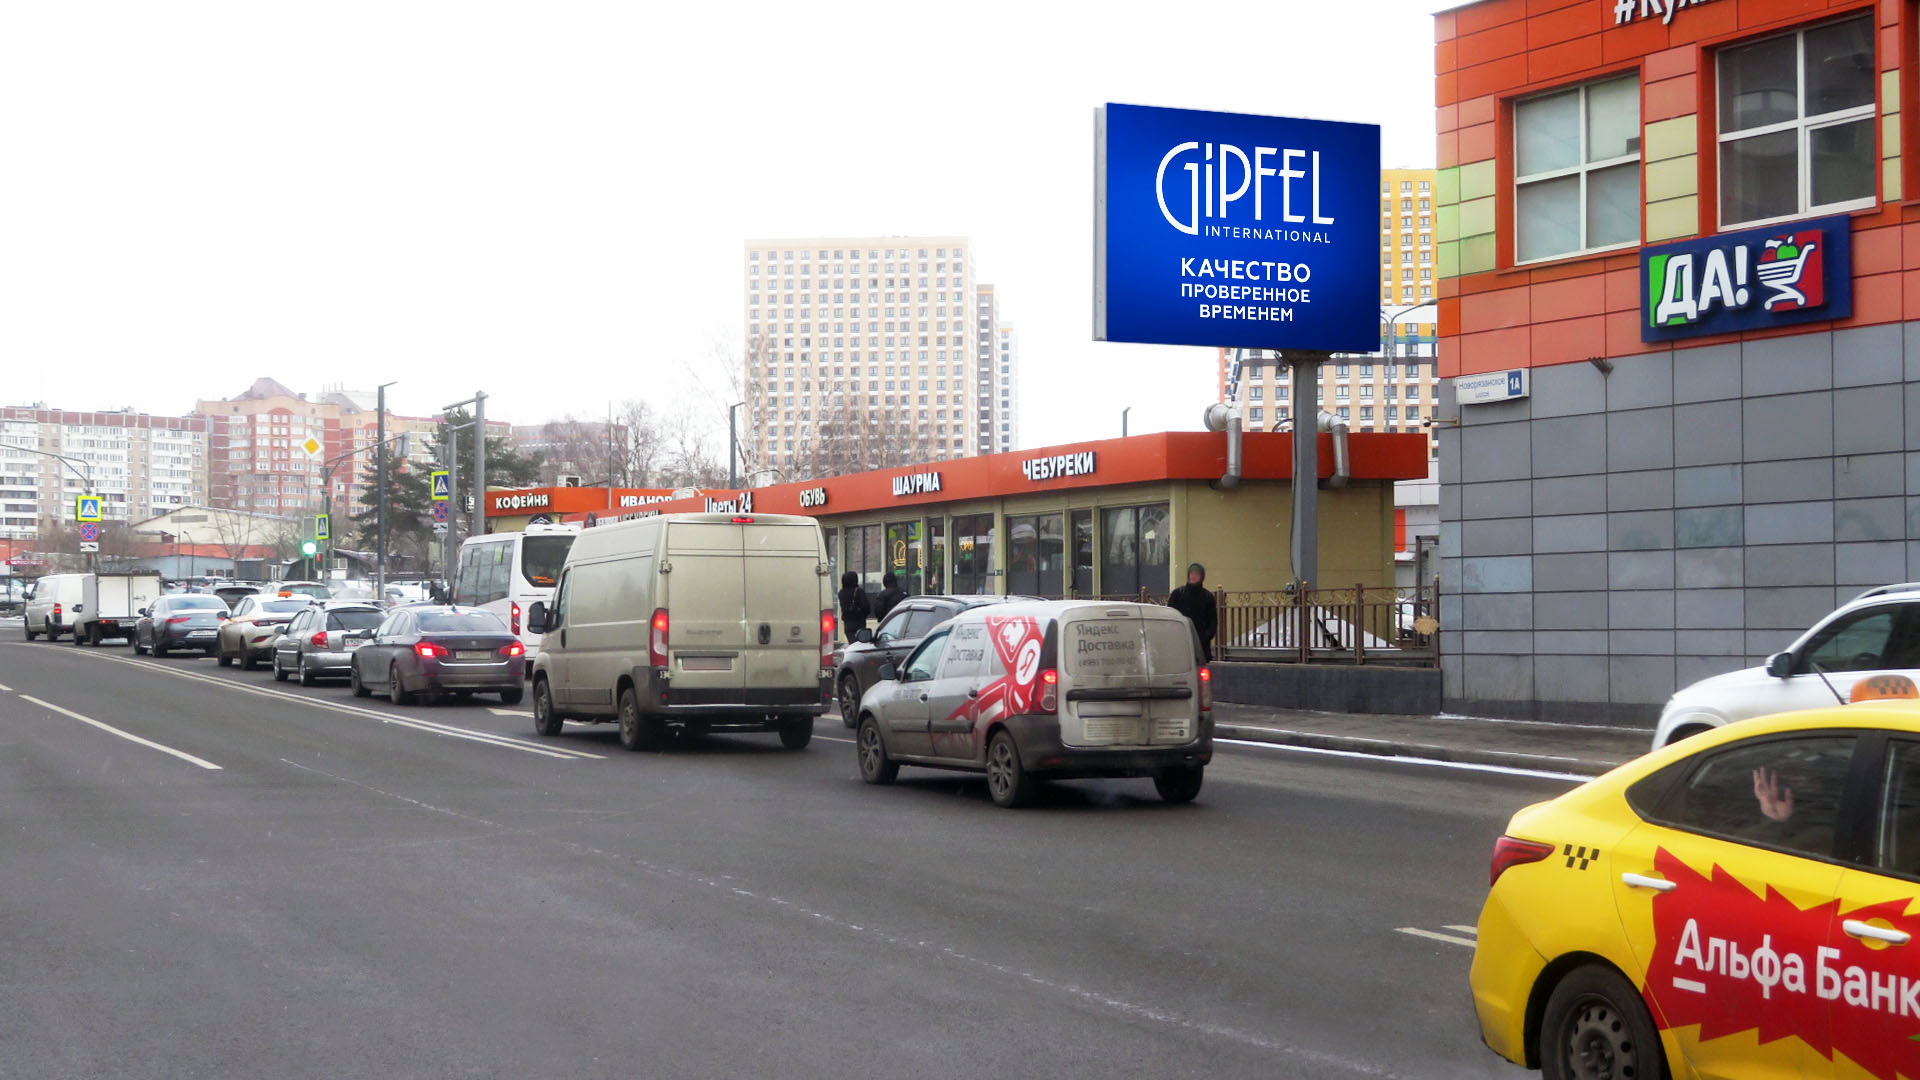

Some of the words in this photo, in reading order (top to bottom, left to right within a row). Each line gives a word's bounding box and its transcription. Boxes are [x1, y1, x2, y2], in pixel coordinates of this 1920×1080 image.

[1205, 225, 1331, 244] INTERNATIONAL
[1181, 257, 1311, 283] КАЧЕСТВО
[1181, 283, 1311, 303] ПРОВЕРЕННОЕ
[1656, 245, 1749, 324] ДА!
[1199, 304, 1293, 322] ВРЕМЕНЕМ
[1509, 377, 1520, 390] 1А
[1022, 452, 1096, 481] ЧЕБУРЕКИ
[893, 472, 940, 496] ШАУРМА
[495, 493, 549, 509] КОФЕЙНЯ
[705, 497, 737, 513] Цветы
[739, 491, 752, 513] 24
[800, 487, 826, 508] ОБУВЬ
[1076, 624, 1120, 637] Яндекс
[1078, 640, 1135, 654] Доставка
[1674, 918, 1806, 999] Альфа
[1816, 945, 1920, 1019] Банк
